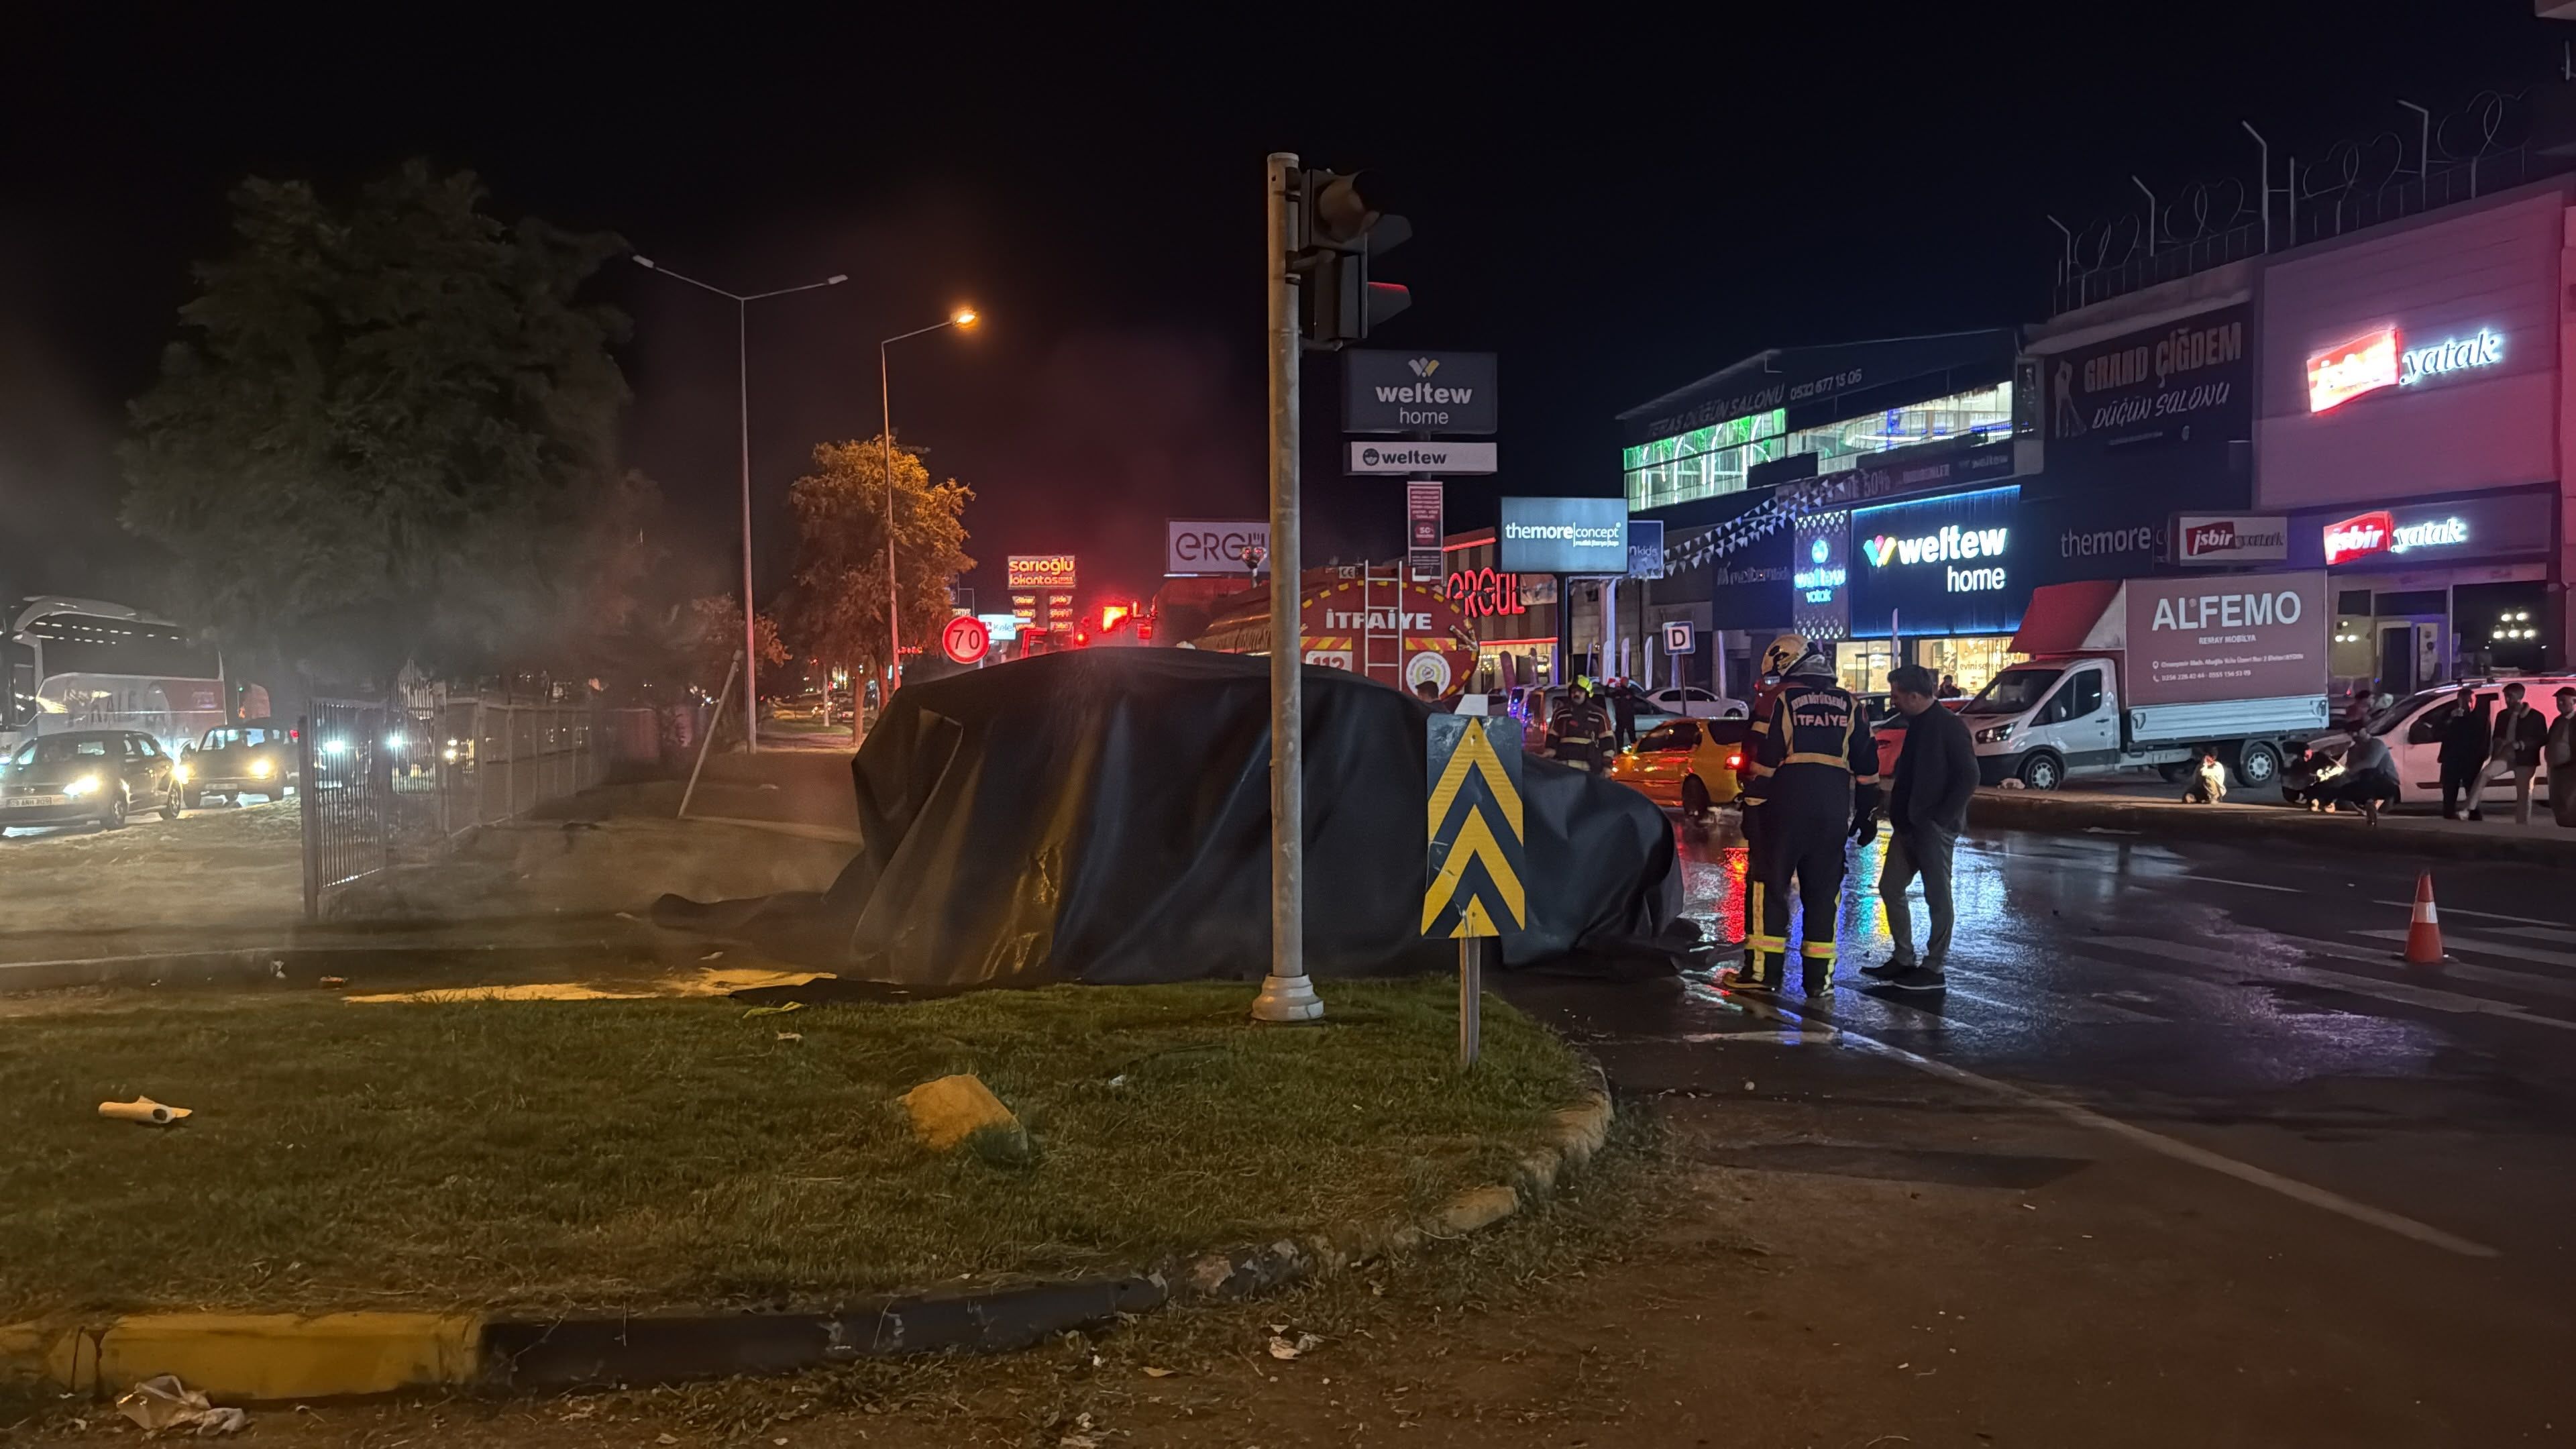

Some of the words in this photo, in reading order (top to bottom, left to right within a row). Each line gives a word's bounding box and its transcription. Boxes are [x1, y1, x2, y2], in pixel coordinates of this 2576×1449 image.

[2084, 347, 2148, 392] GRAND
[2155, 321, 2241, 389] ÇİĞDEM
[1376, 382, 1472, 403] weltew
[1729, 381, 1784, 416] SALONU
[2154, 382, 2230, 418] SALONU
[1399, 407, 1449, 425] home
[1382, 450, 1447, 465] weltew
[1898, 525, 2007, 565] weltew
[2061, 526, 2152, 557] themore
[1948, 566, 2006, 592] home
[1326, 608, 1432, 630] İTFAİYE
[2152, 591, 2301, 631] ALFEMO
[953, 630, 980, 649] 70
[1672, 629, 1686, 647] D
[1792, 712, 1848, 727] İTFAİYE
